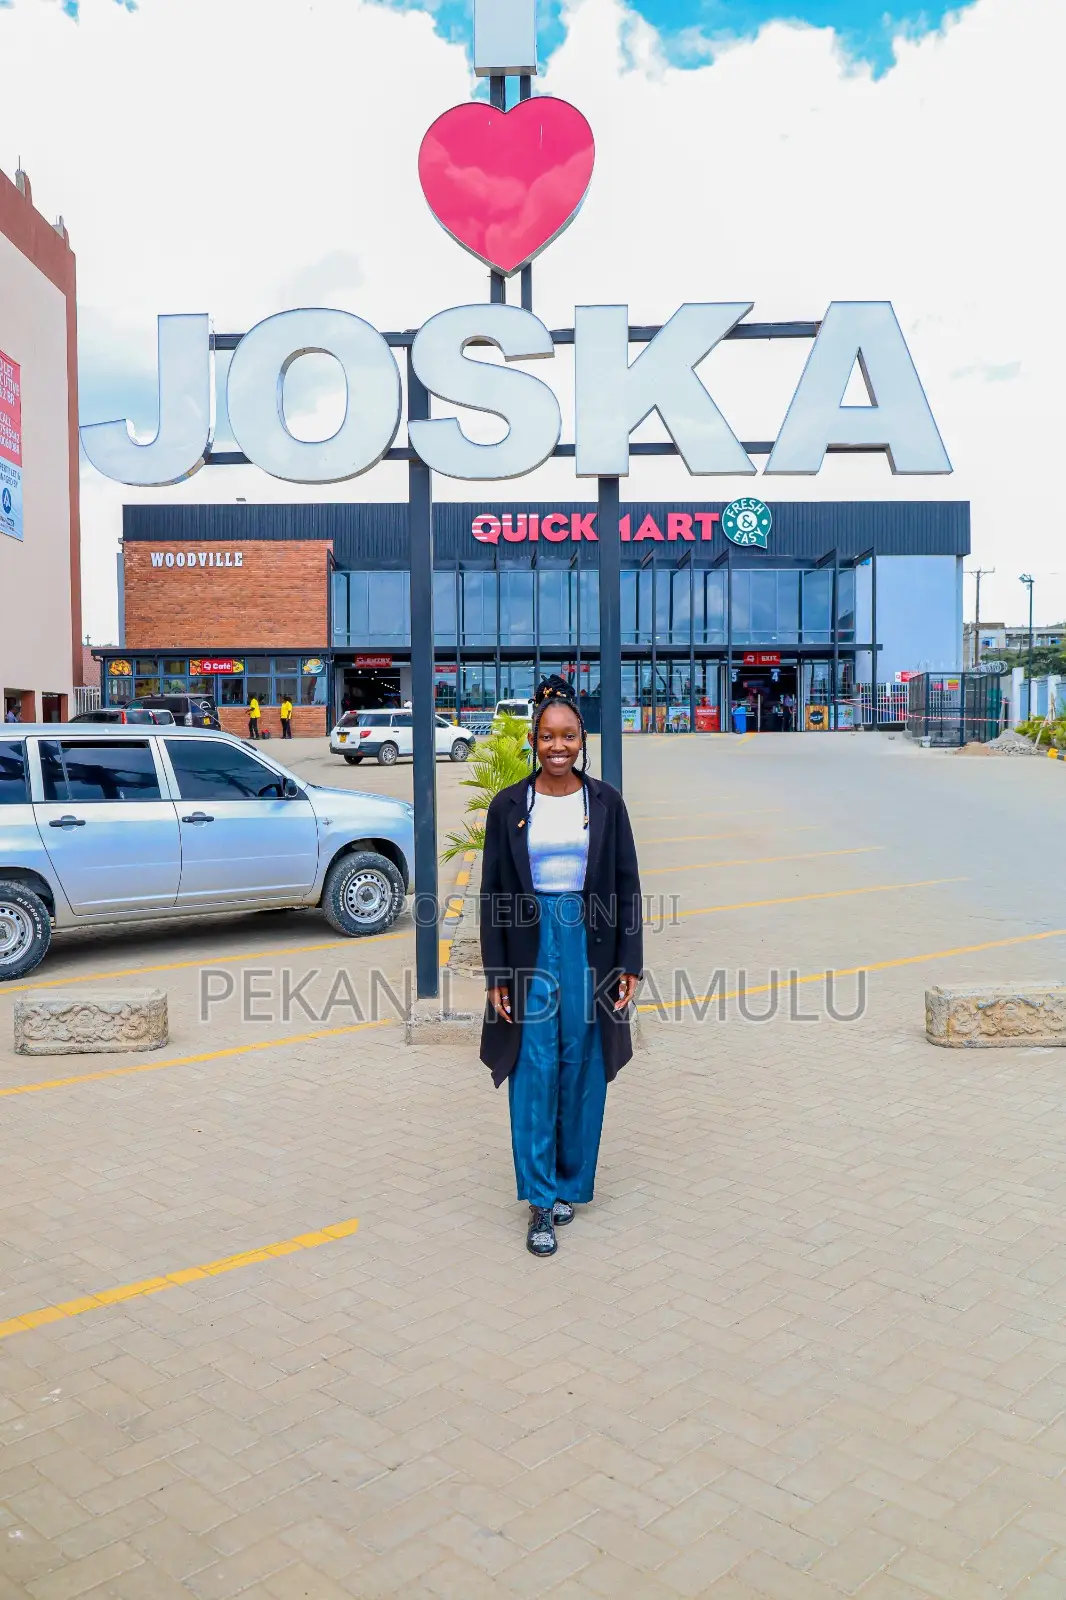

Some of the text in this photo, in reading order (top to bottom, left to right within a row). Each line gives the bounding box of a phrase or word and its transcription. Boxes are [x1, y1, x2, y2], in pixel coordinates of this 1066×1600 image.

[79, 300, 953, 485] JOSKA
[726, 499, 765, 518] FRESH
[472, 513, 719, 545] QUICKART
[742, 514, 753, 529] &
[733, 527, 764, 544] EASY
[150, 552, 243, 568] WOODVILLE
[213, 662, 231, 670] Café
[772, 671, 778, 682] 4
